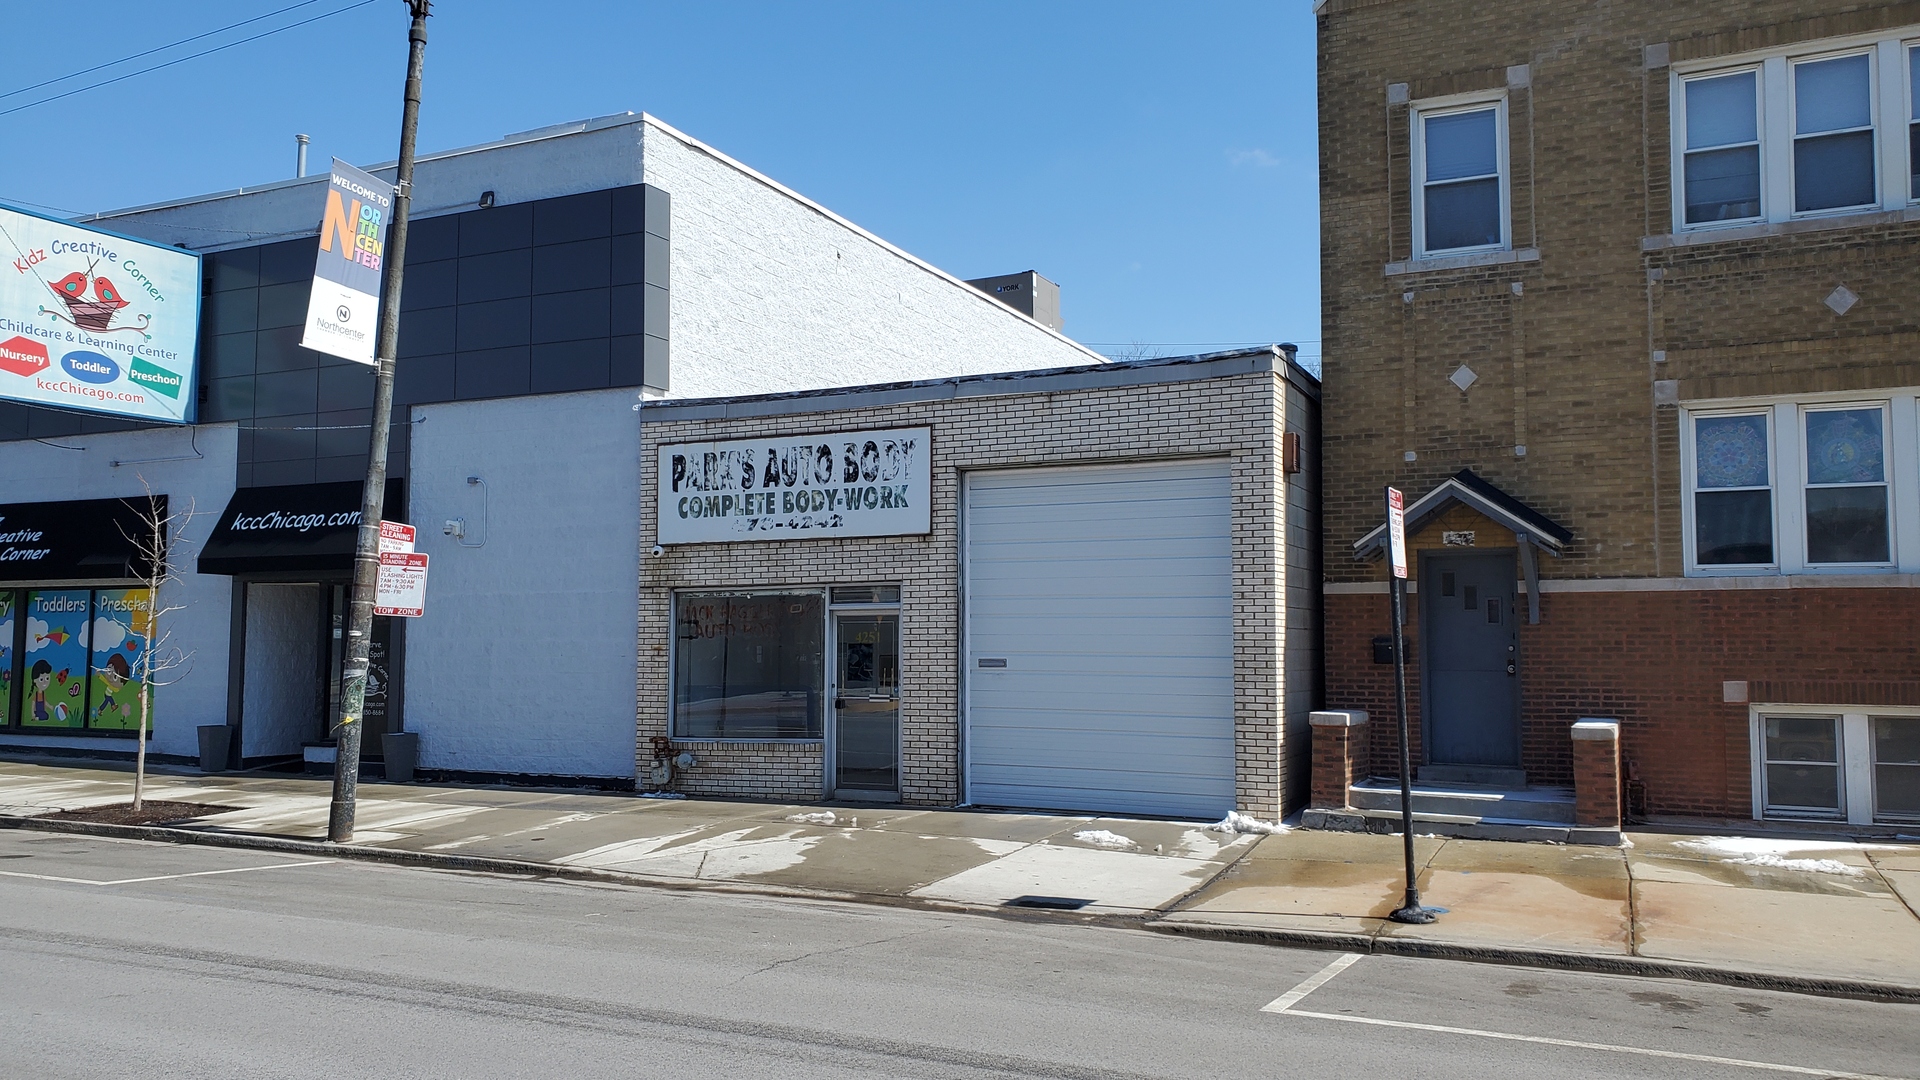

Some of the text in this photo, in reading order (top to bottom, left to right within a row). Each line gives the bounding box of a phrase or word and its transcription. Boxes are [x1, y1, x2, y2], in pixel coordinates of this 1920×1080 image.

[332, 174, 389, 207] WELCOME TO
[361, 205, 382, 225] OR
[320, 189, 361, 261] N
[359, 218, 379, 240] TH
[356, 234, 382, 257] CEN
[355, 248, 380, 270] TER
[13, 239, 165, 303] Kidz Creative Corner
[1002, 284, 1019, 292] YORK
[317, 318, 365, 339] Northcenter
[0, 318, 178, 361] Childcare & Learning Center
[0, 347, 45, 366] Nursery
[70, 359, 111, 375] Toddler
[131, 369, 179, 386] Preschool
[36, 378, 144, 404] kccChicago.com
[763, 443, 834, 488] AUTO
[843, 437, 918, 483] BODY
[678, 484, 909, 519] COMPLETE BODY-WORK
[231, 510, 362, 532] kccChicago.com
[382, 523, 403, 532] STREET
[0, 528, 43, 543] eative
[381, 530, 411, 540] CLEANING
[388, 539, 404, 547] PARKING
[1, 547, 50, 561] Corner
[35, 596, 86, 612] Toddlers
[101, 595, 155, 612] Prescho
[397, 608, 418, 616] ZONE
[856, 631, 880, 643] 4251
[369, 651, 385, 659] Spot!
